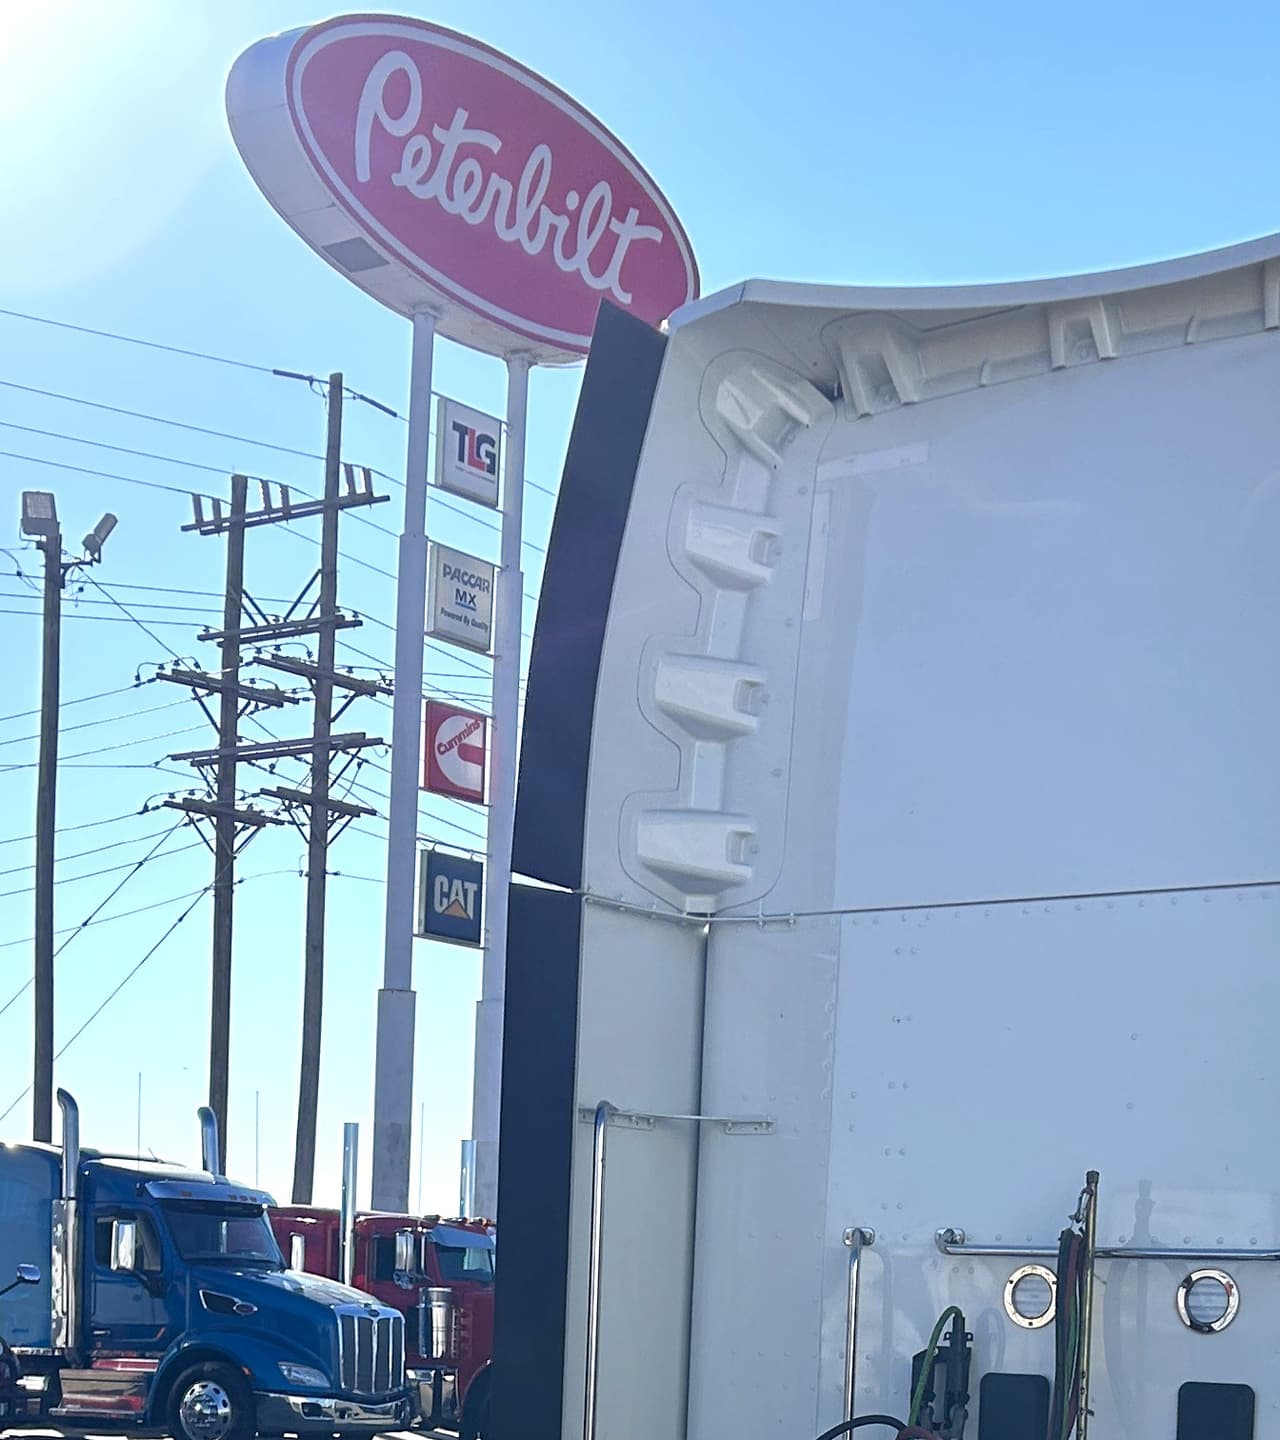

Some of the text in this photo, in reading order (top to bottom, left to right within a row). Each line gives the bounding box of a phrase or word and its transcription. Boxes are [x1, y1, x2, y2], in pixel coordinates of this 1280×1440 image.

[354, 49, 663, 304] Peterbilt
[452, 420, 496, 476] TLG
[443, 563, 490, 594] PACCAR
[455, 588, 477, 608] MX
[437, 719, 481, 755] Cummins
[433, 874, 478, 920] CAT
